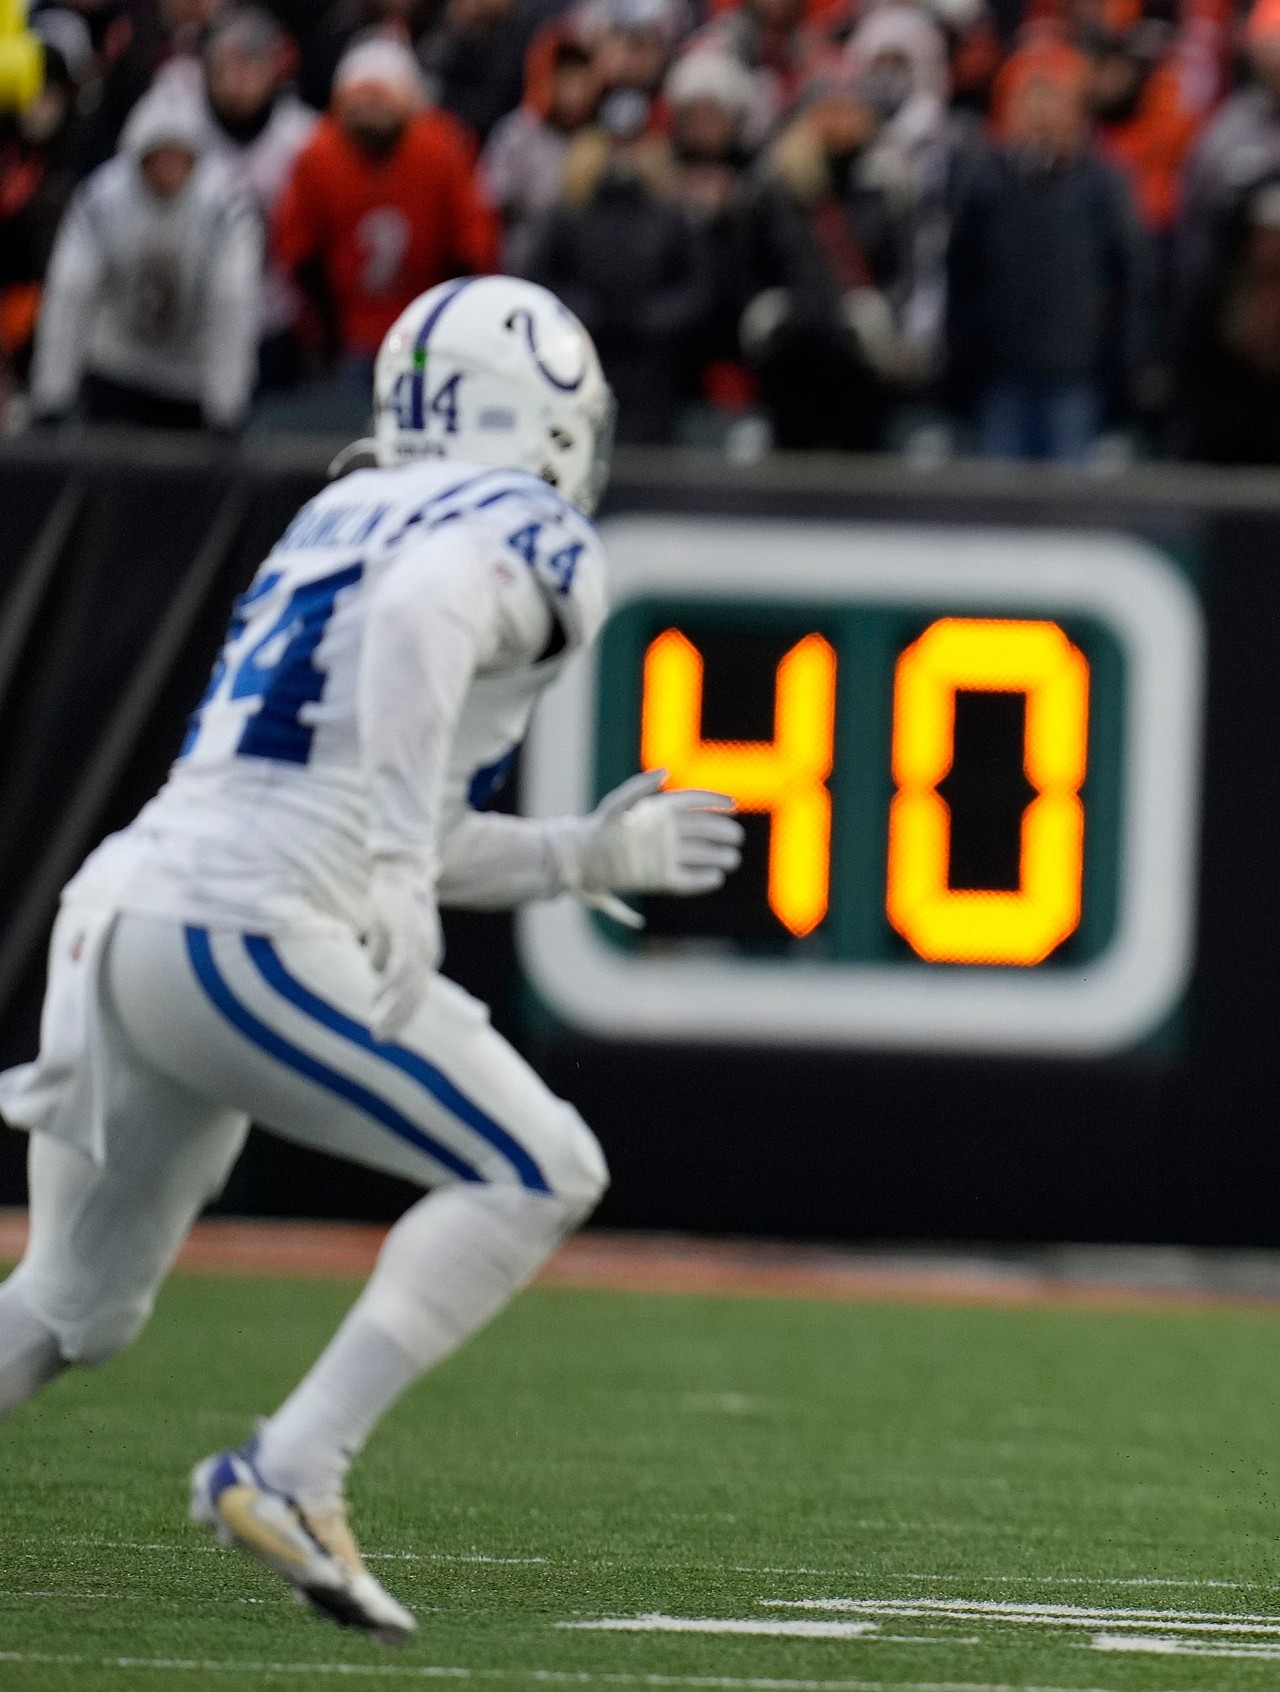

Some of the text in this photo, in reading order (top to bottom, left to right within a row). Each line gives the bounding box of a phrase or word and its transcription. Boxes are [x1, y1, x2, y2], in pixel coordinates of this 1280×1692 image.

[389, 370, 464, 433] 44
[507, 521, 584, 597] 44
[641, 613, 1090, 966] 40
